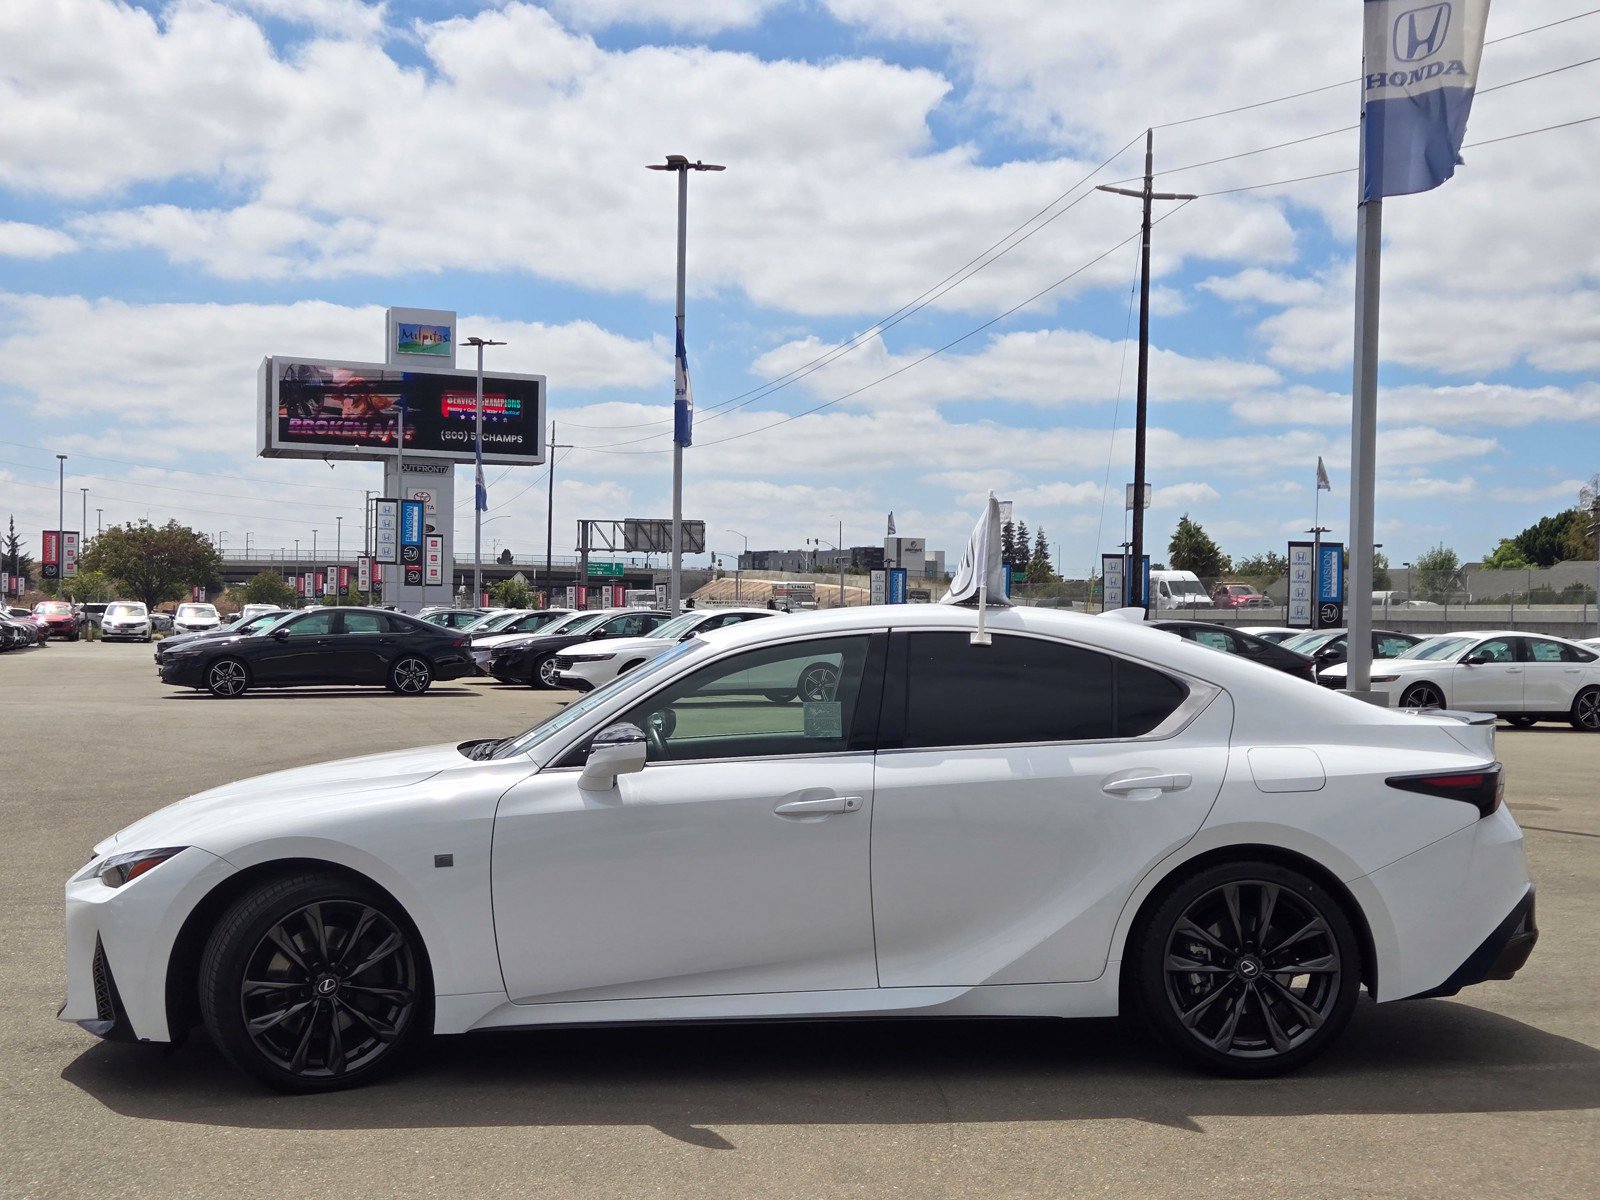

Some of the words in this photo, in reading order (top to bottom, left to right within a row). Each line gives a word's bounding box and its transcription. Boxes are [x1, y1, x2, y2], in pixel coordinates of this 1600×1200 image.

[1366, 60, 1468, 90] HONDA
[401, 325, 448, 346] Milpitas
[481, 397, 521, 409] HAMPIONS
[287, 418, 368, 437] BROKEN
[440, 430, 468, 442] (800)
[405, 505, 414, 541] ENVISION
[1323, 551, 1332, 598] ENVISION
